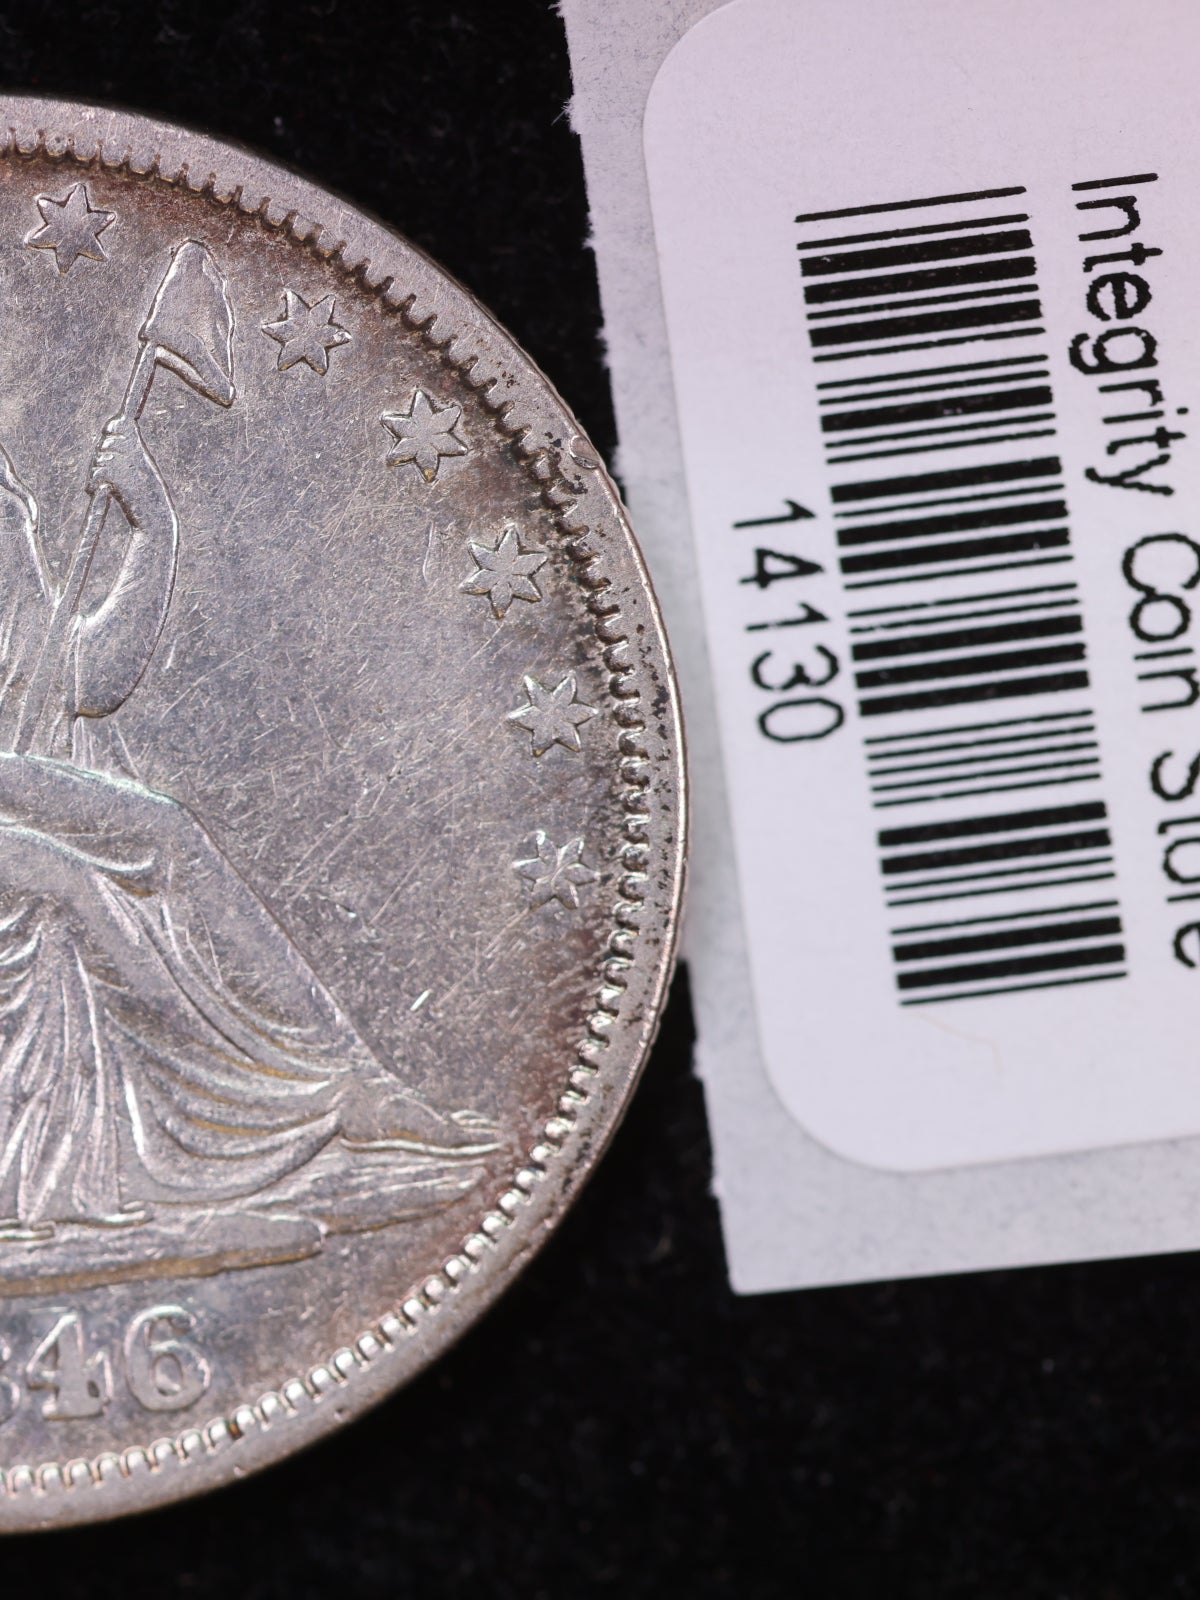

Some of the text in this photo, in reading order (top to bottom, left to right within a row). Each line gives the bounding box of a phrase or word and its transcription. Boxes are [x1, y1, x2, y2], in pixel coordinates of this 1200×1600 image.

[1068, 172, 1189, 497] Integrity
[732, 498, 845, 743] 14130
[1121, 532, 1200, 714] Coin
